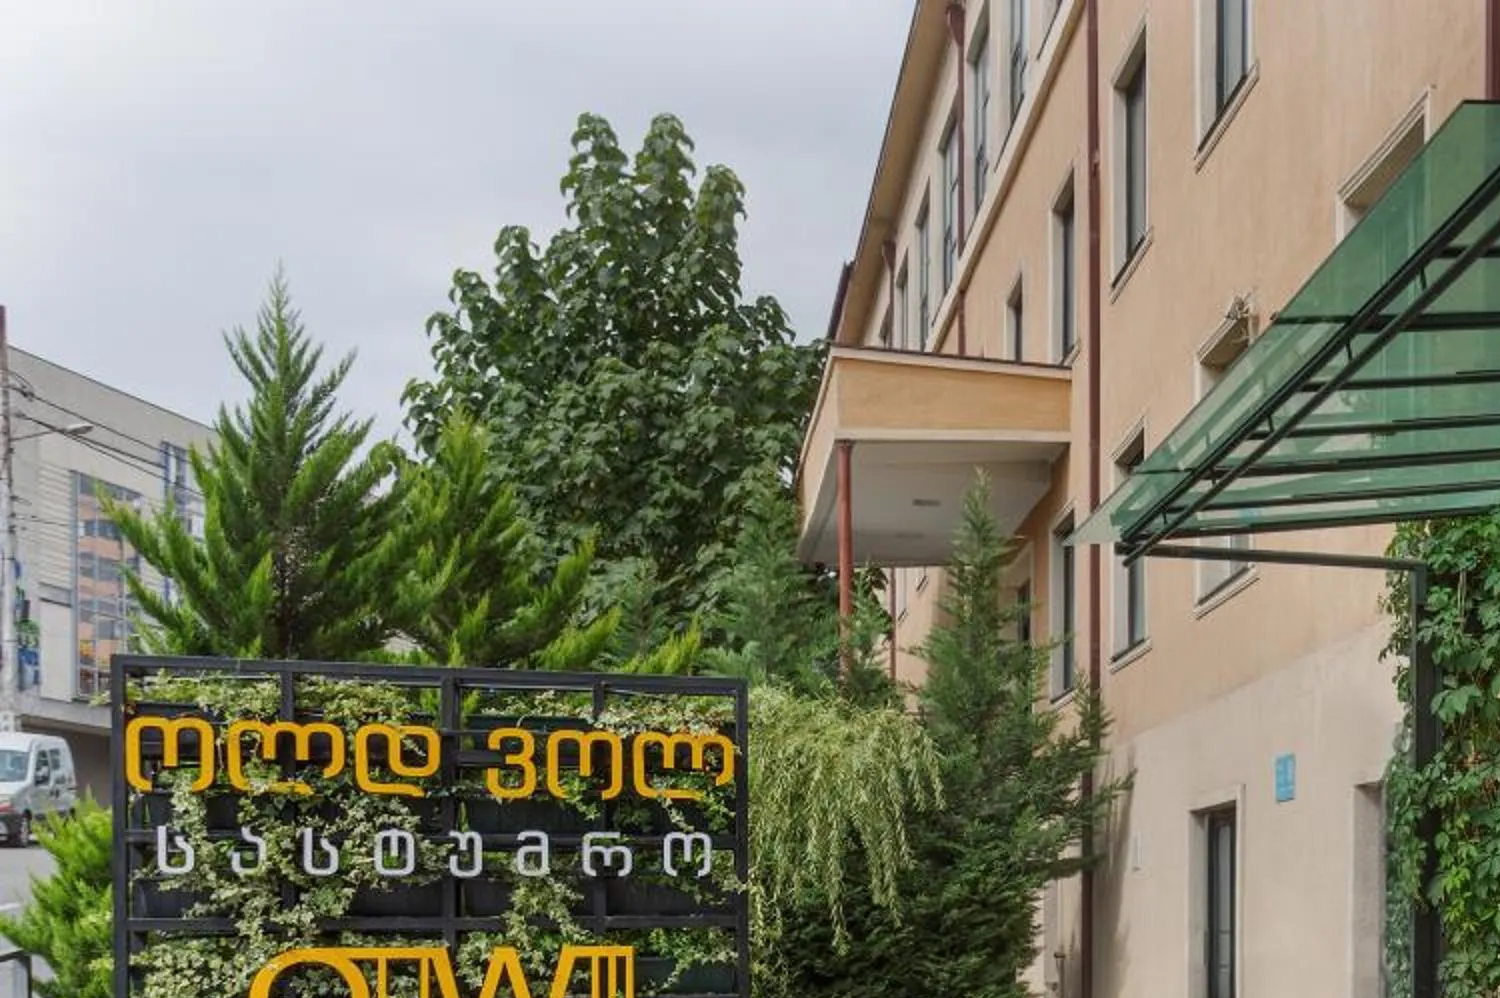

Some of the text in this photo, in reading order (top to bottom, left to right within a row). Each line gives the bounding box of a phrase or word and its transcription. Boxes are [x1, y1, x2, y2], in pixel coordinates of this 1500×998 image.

[125, 716, 734, 801] ოლდ ვოლ
[157, 825, 711, 878] სასტუმრო
